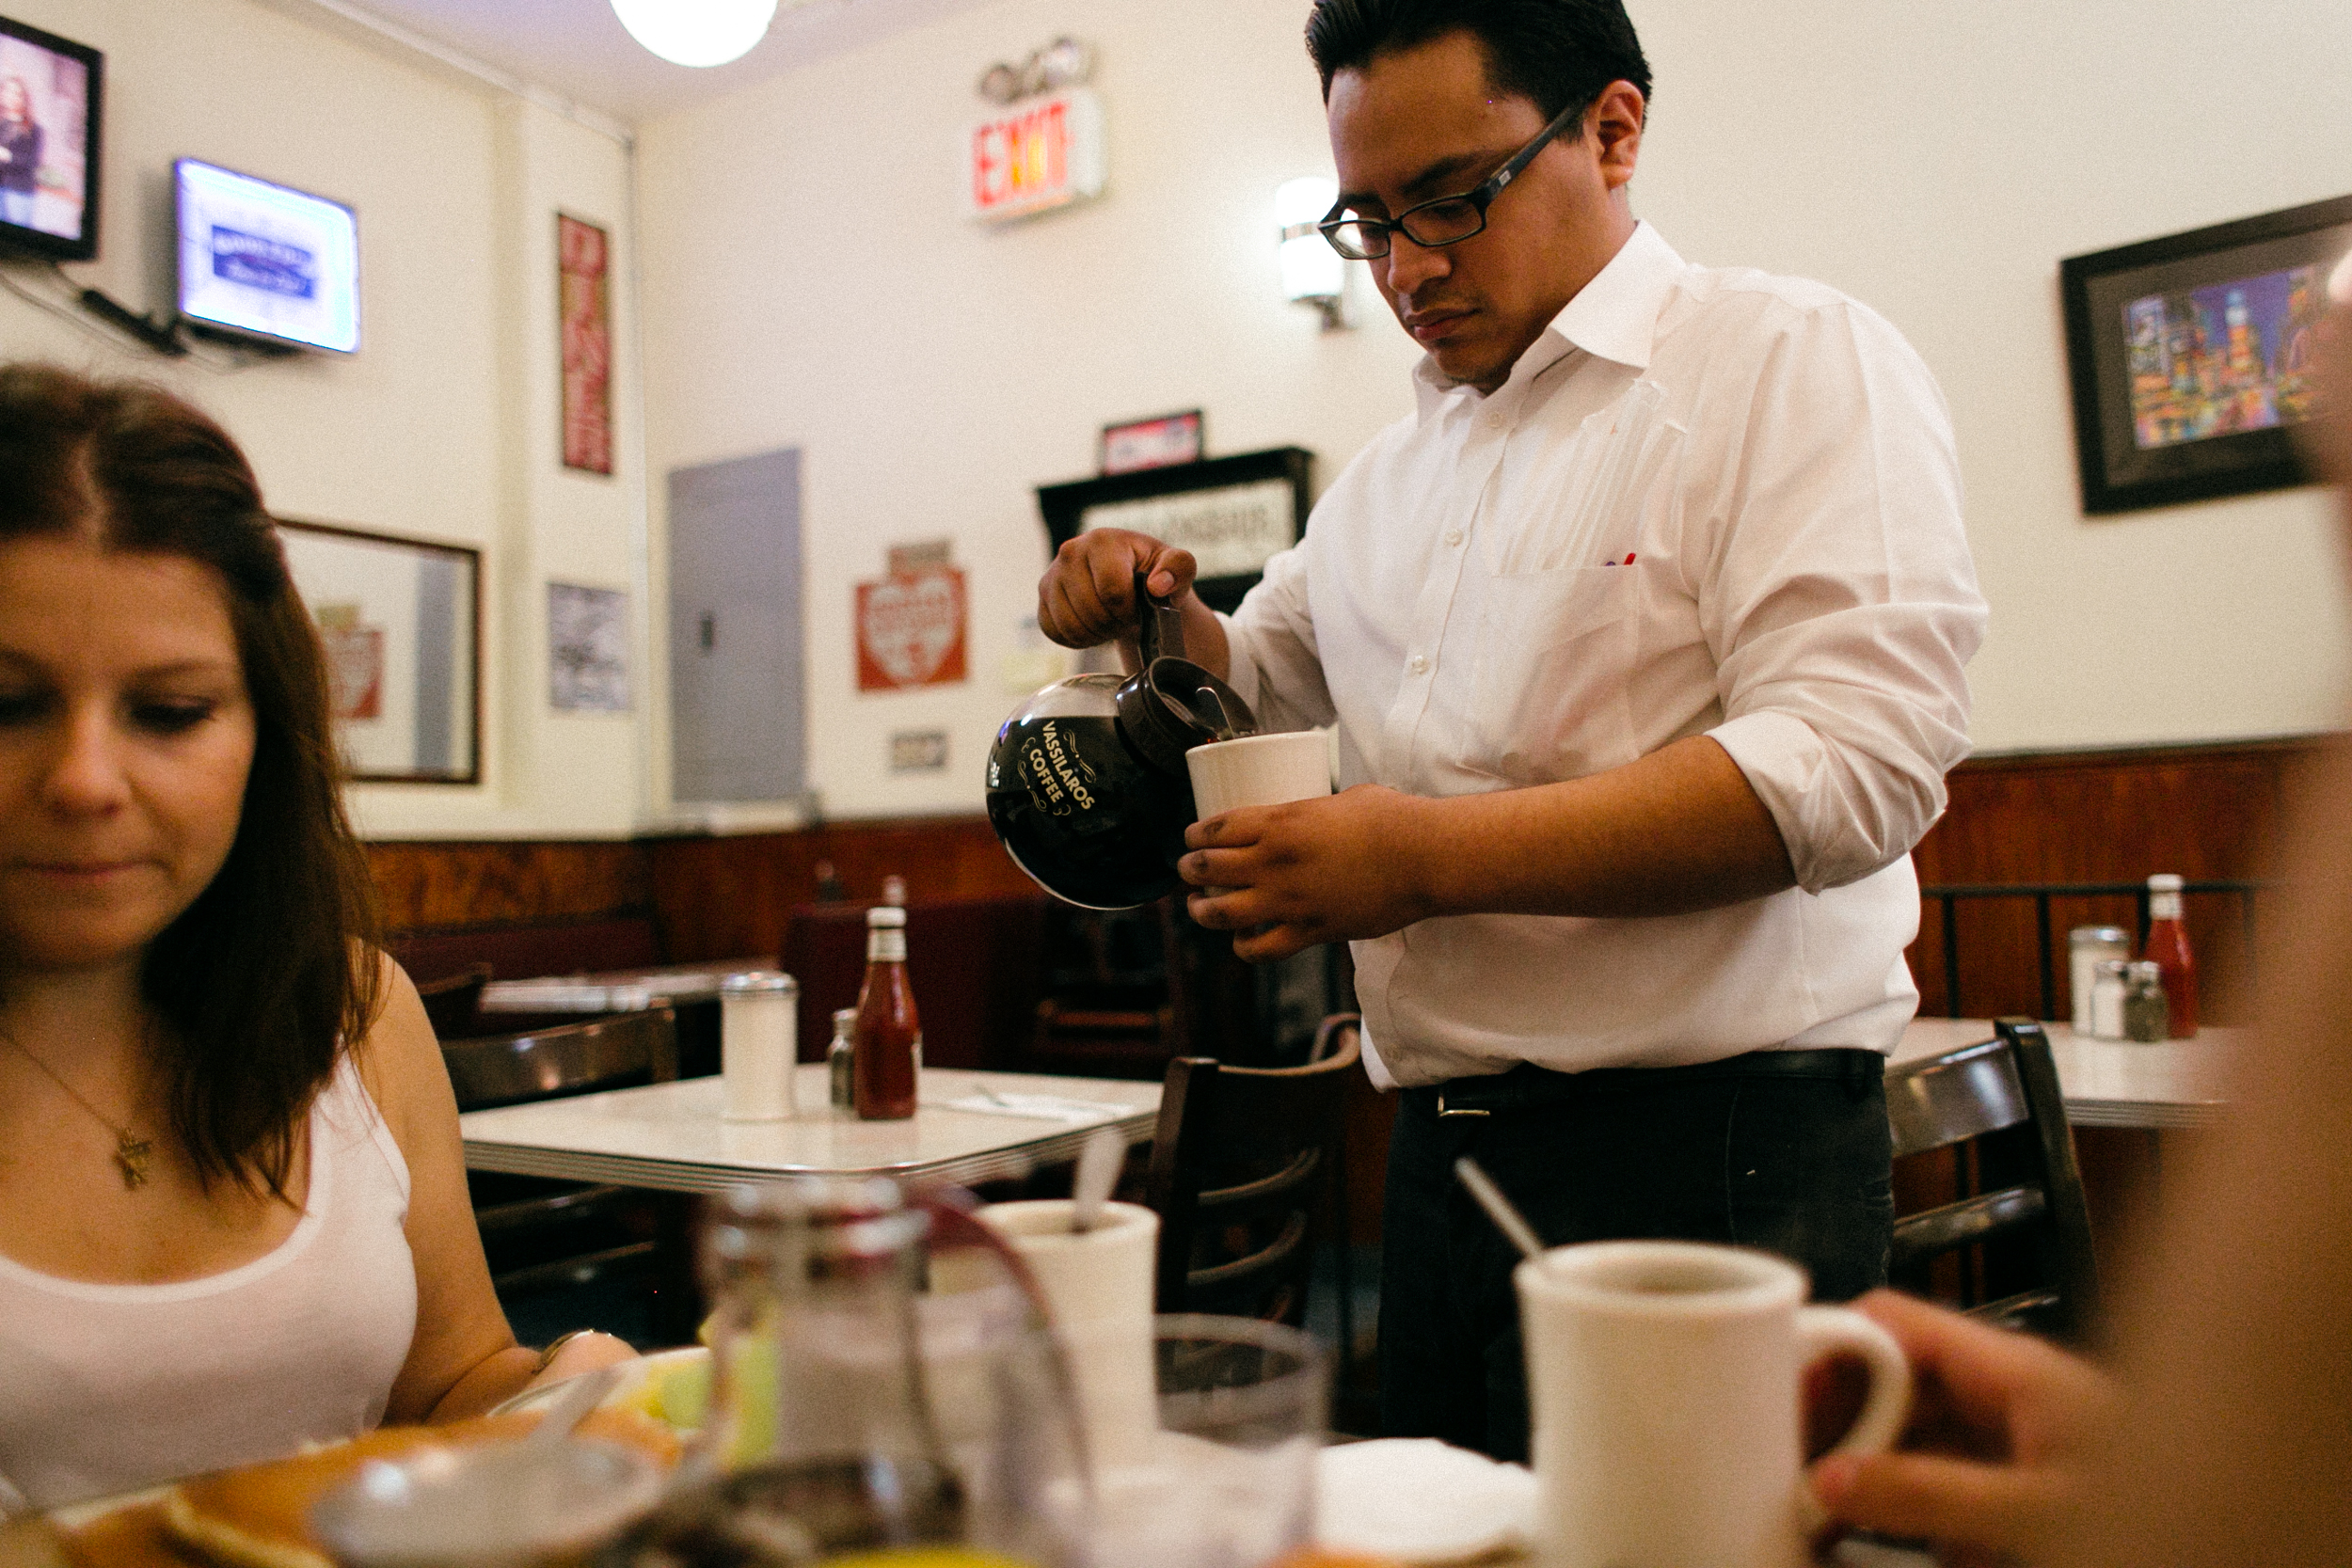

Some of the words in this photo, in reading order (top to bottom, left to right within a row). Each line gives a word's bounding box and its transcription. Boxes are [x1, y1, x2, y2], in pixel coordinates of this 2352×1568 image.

[973, 102, 1072, 208] EXIT
[1029, 748, 1064, 803] COFFEE
[1042, 721, 1095, 810] VASSILAROS
